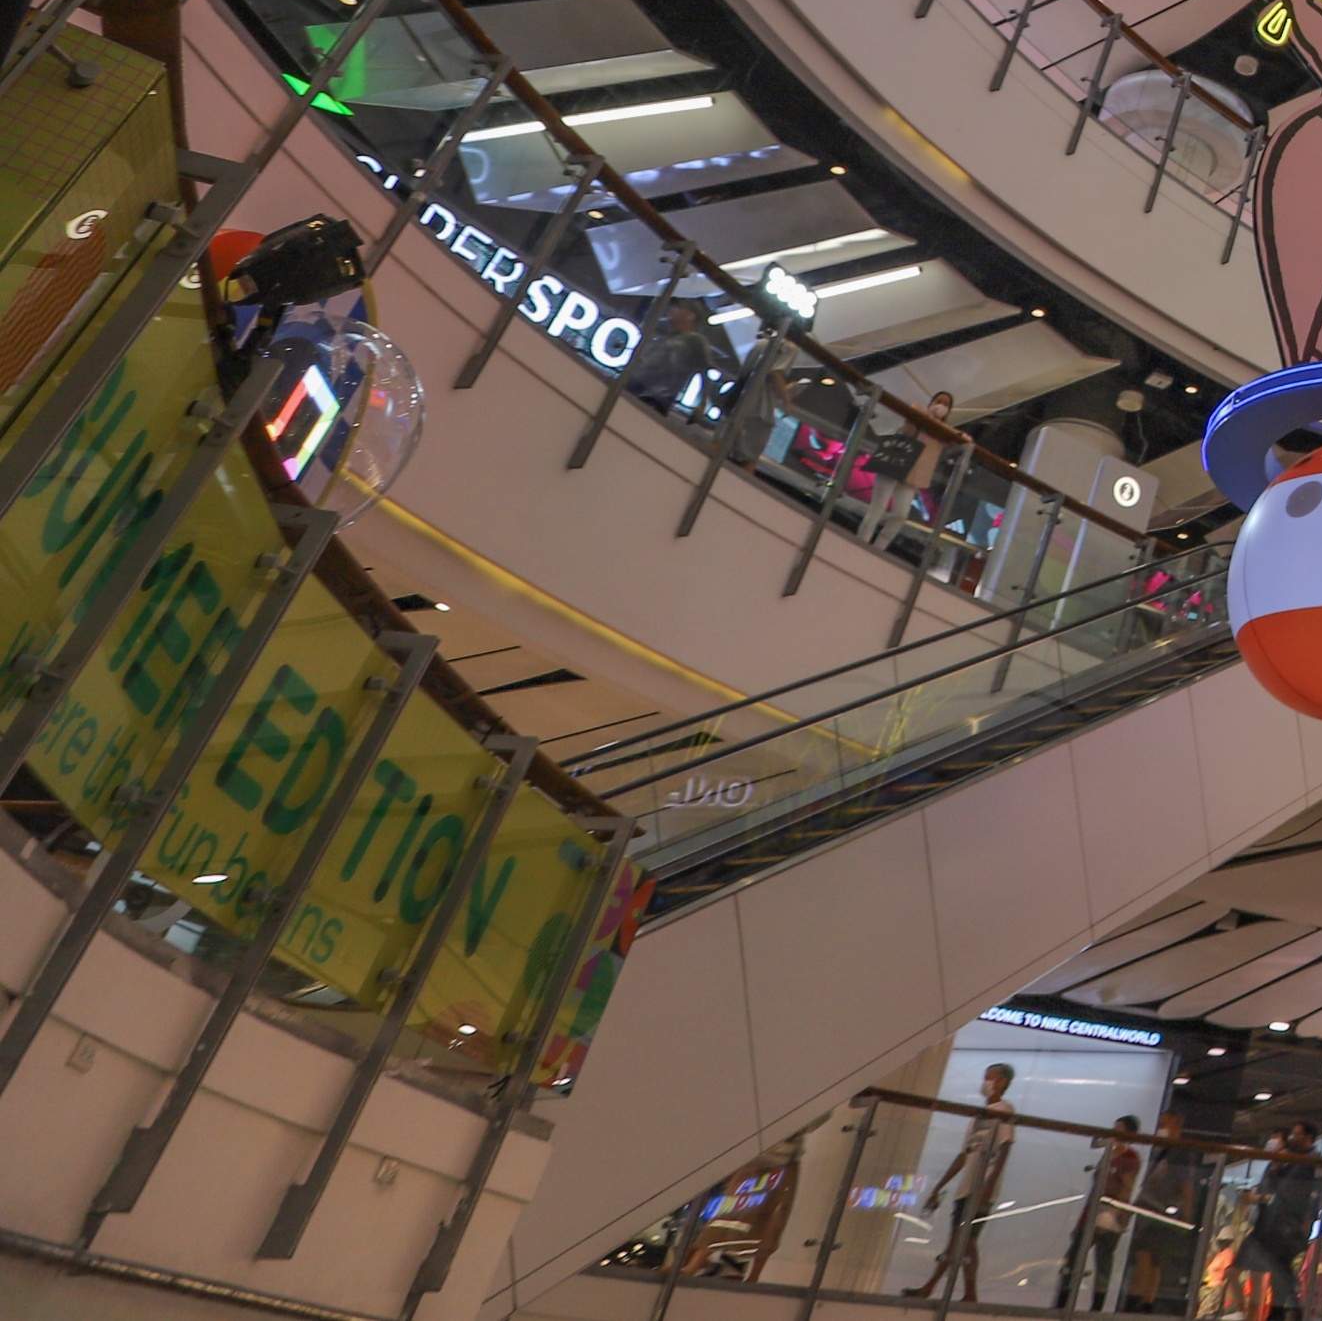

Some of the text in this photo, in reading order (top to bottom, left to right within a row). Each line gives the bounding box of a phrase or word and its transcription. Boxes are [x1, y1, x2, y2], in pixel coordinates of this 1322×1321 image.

[215, 664, 518, 959] EDTION
[209, 831, 344, 964] bens
[1025, 1013, 1041, 1027] TO
[1069, 1020, 1162, 1047] CENTRALWORLD
